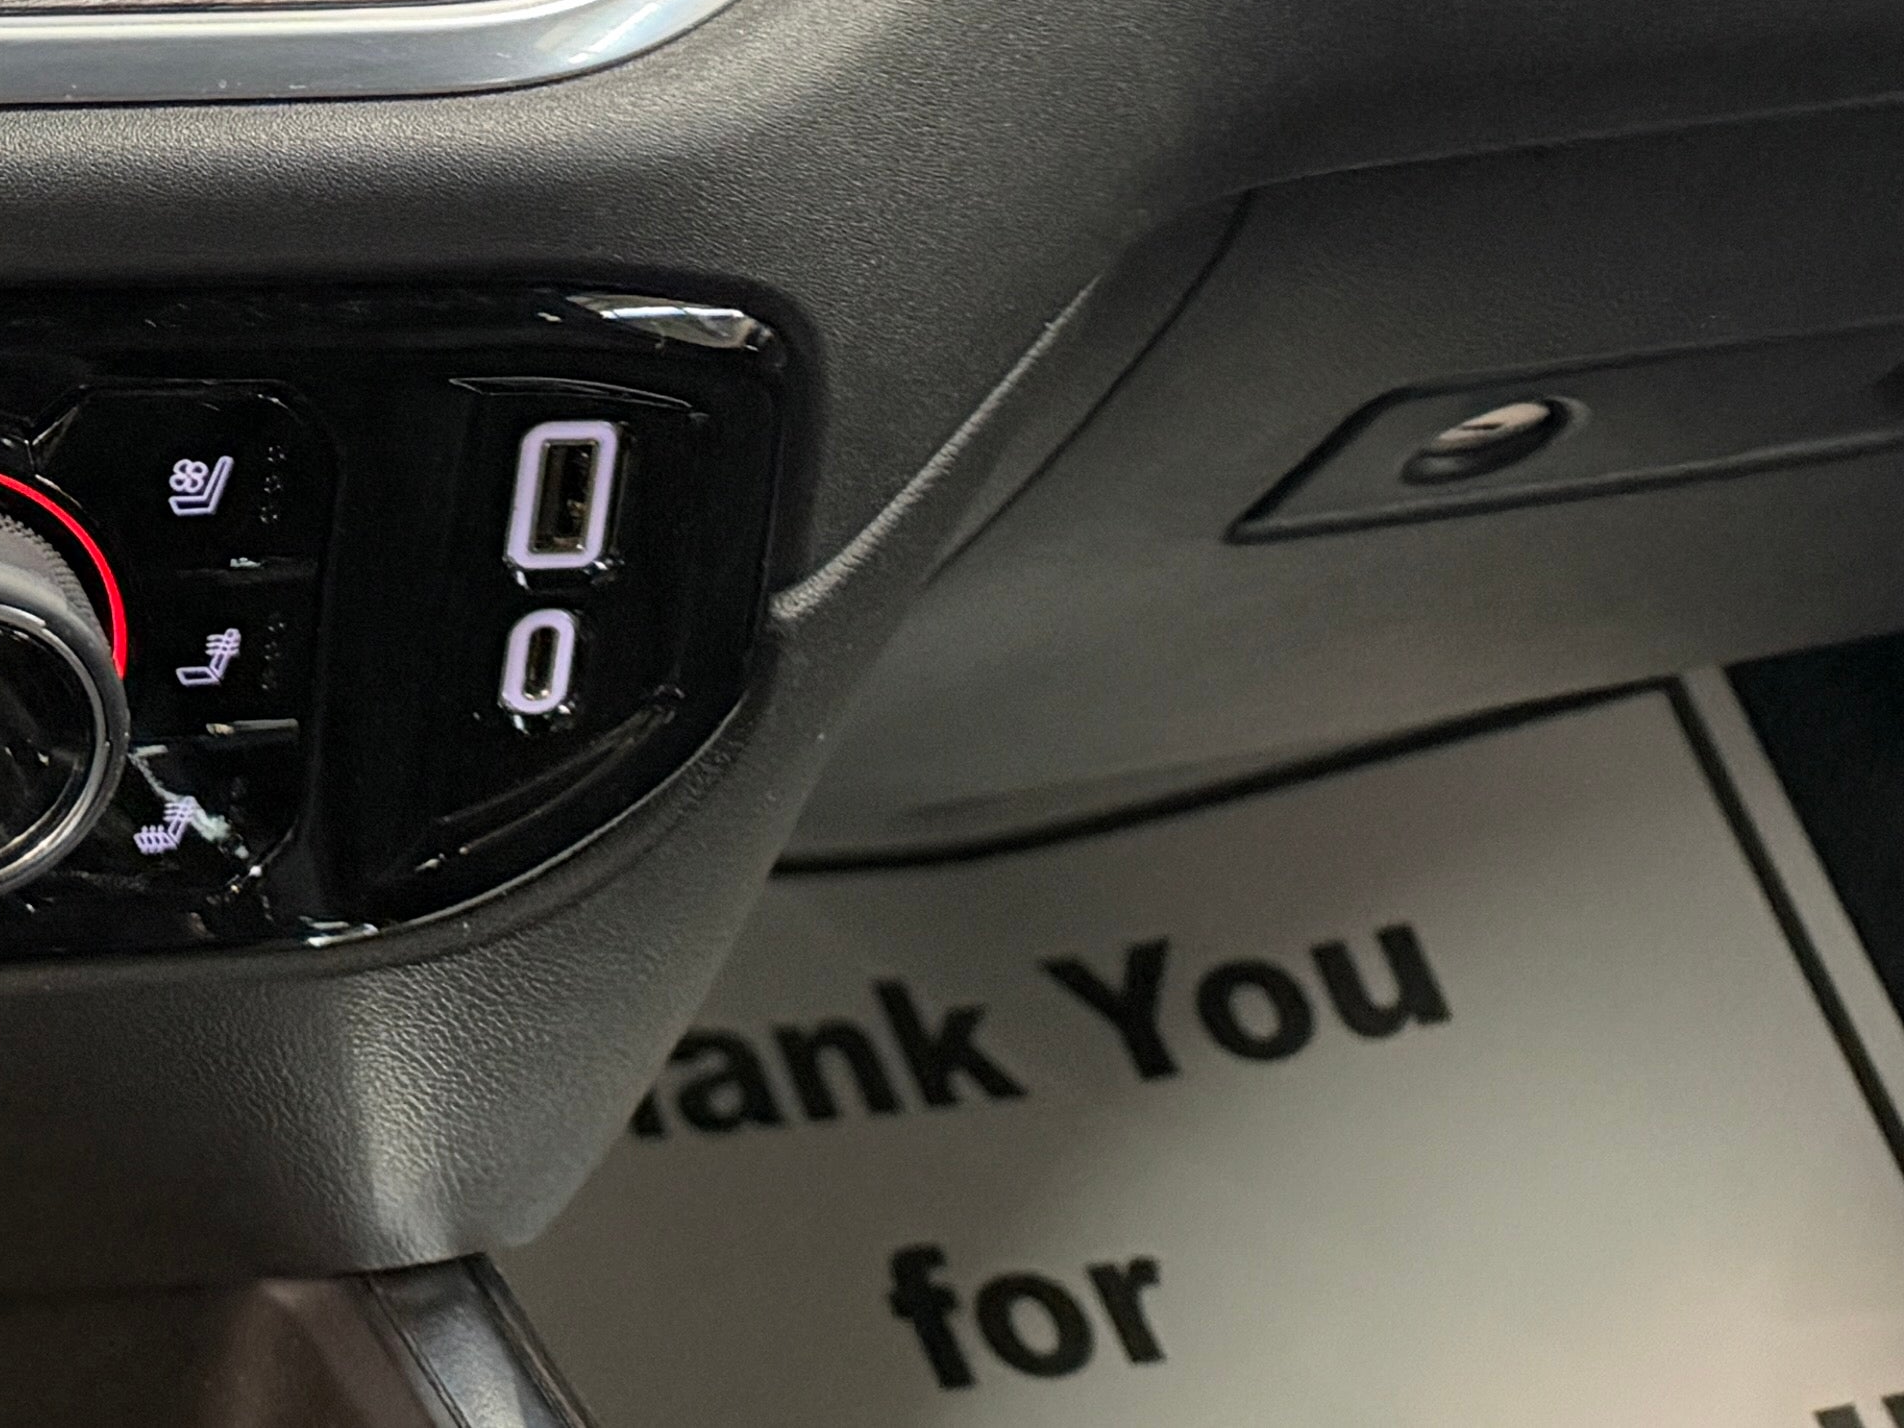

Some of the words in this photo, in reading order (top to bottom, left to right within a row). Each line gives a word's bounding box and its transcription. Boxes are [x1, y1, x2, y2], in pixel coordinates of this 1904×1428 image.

[630, 980, 1028, 1140] ank
[1042, 920, 1454, 1084] You
[886, 1242, 1168, 1391] for
